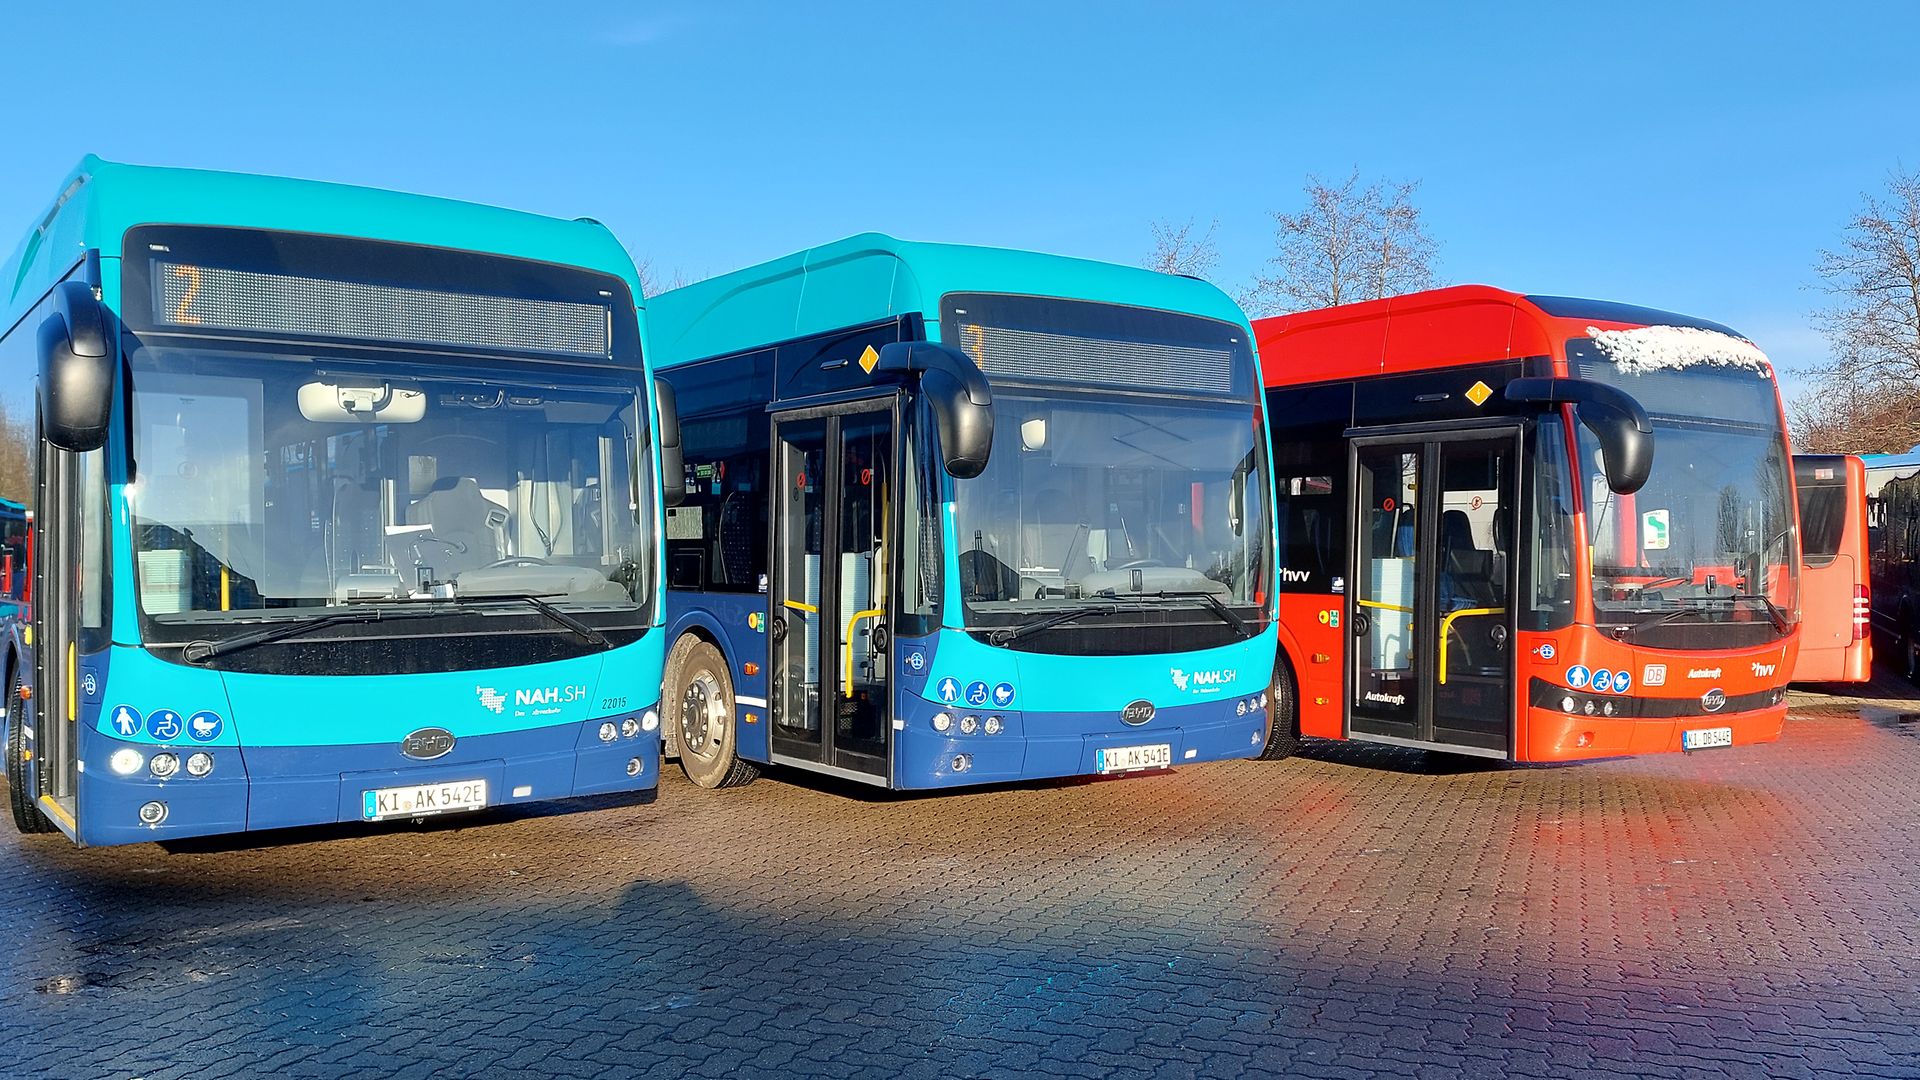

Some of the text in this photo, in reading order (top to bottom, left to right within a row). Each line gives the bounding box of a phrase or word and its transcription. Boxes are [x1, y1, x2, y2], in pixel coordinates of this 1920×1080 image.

[176, 264, 202, 324] 2
[1282, 567, 1310, 582] hvv
[1193, 669, 1237, 685] NAH.SH
[1687, 667, 1722, 680] Autokraft
[1754, 662, 1776, 677] hvv
[515, 685, 587, 706] NAH.SH
[602, 696, 627, 710] 22015
[1365, 690, 1406, 706] Autokraft
[1703, 694, 1724, 706] BYD
[1125, 705, 1152, 719] BYD
[407, 735, 451, 752] BYD
[1688, 732, 1698, 747] KI
[1105, 747, 1169, 768] KI AK 541E
[378, 784, 483, 813] KI AK 542E
